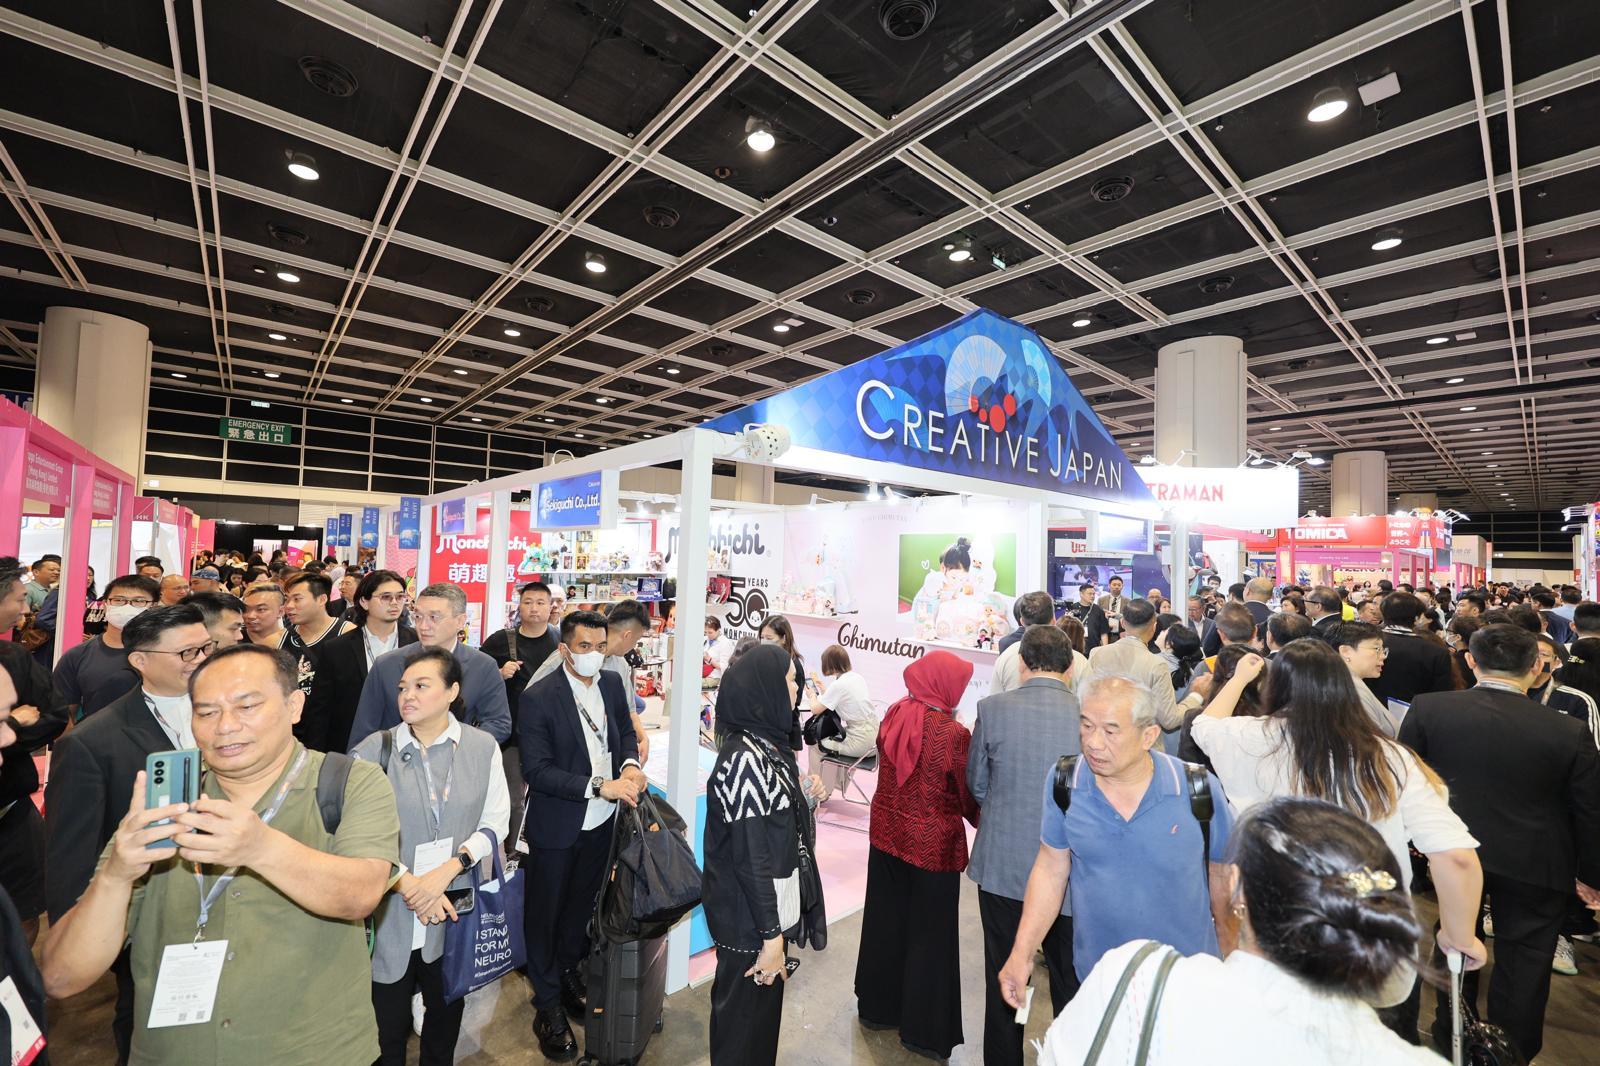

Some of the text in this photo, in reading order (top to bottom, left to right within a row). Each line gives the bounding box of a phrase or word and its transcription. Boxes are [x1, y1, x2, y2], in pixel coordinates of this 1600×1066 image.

[228, 419, 285, 433] EMERGENCY EXIT
[228, 427, 284, 443] 緊急出口
[1050, 433, 1123, 490] JAPAN
[747, 578, 769, 588] YEARS
[837, 622, 925, 659] Chimutan
[476, 924, 508, 941] I STAND
[475, 935, 509, 954] FOR MY
[474, 948, 512, 968] NEURO
